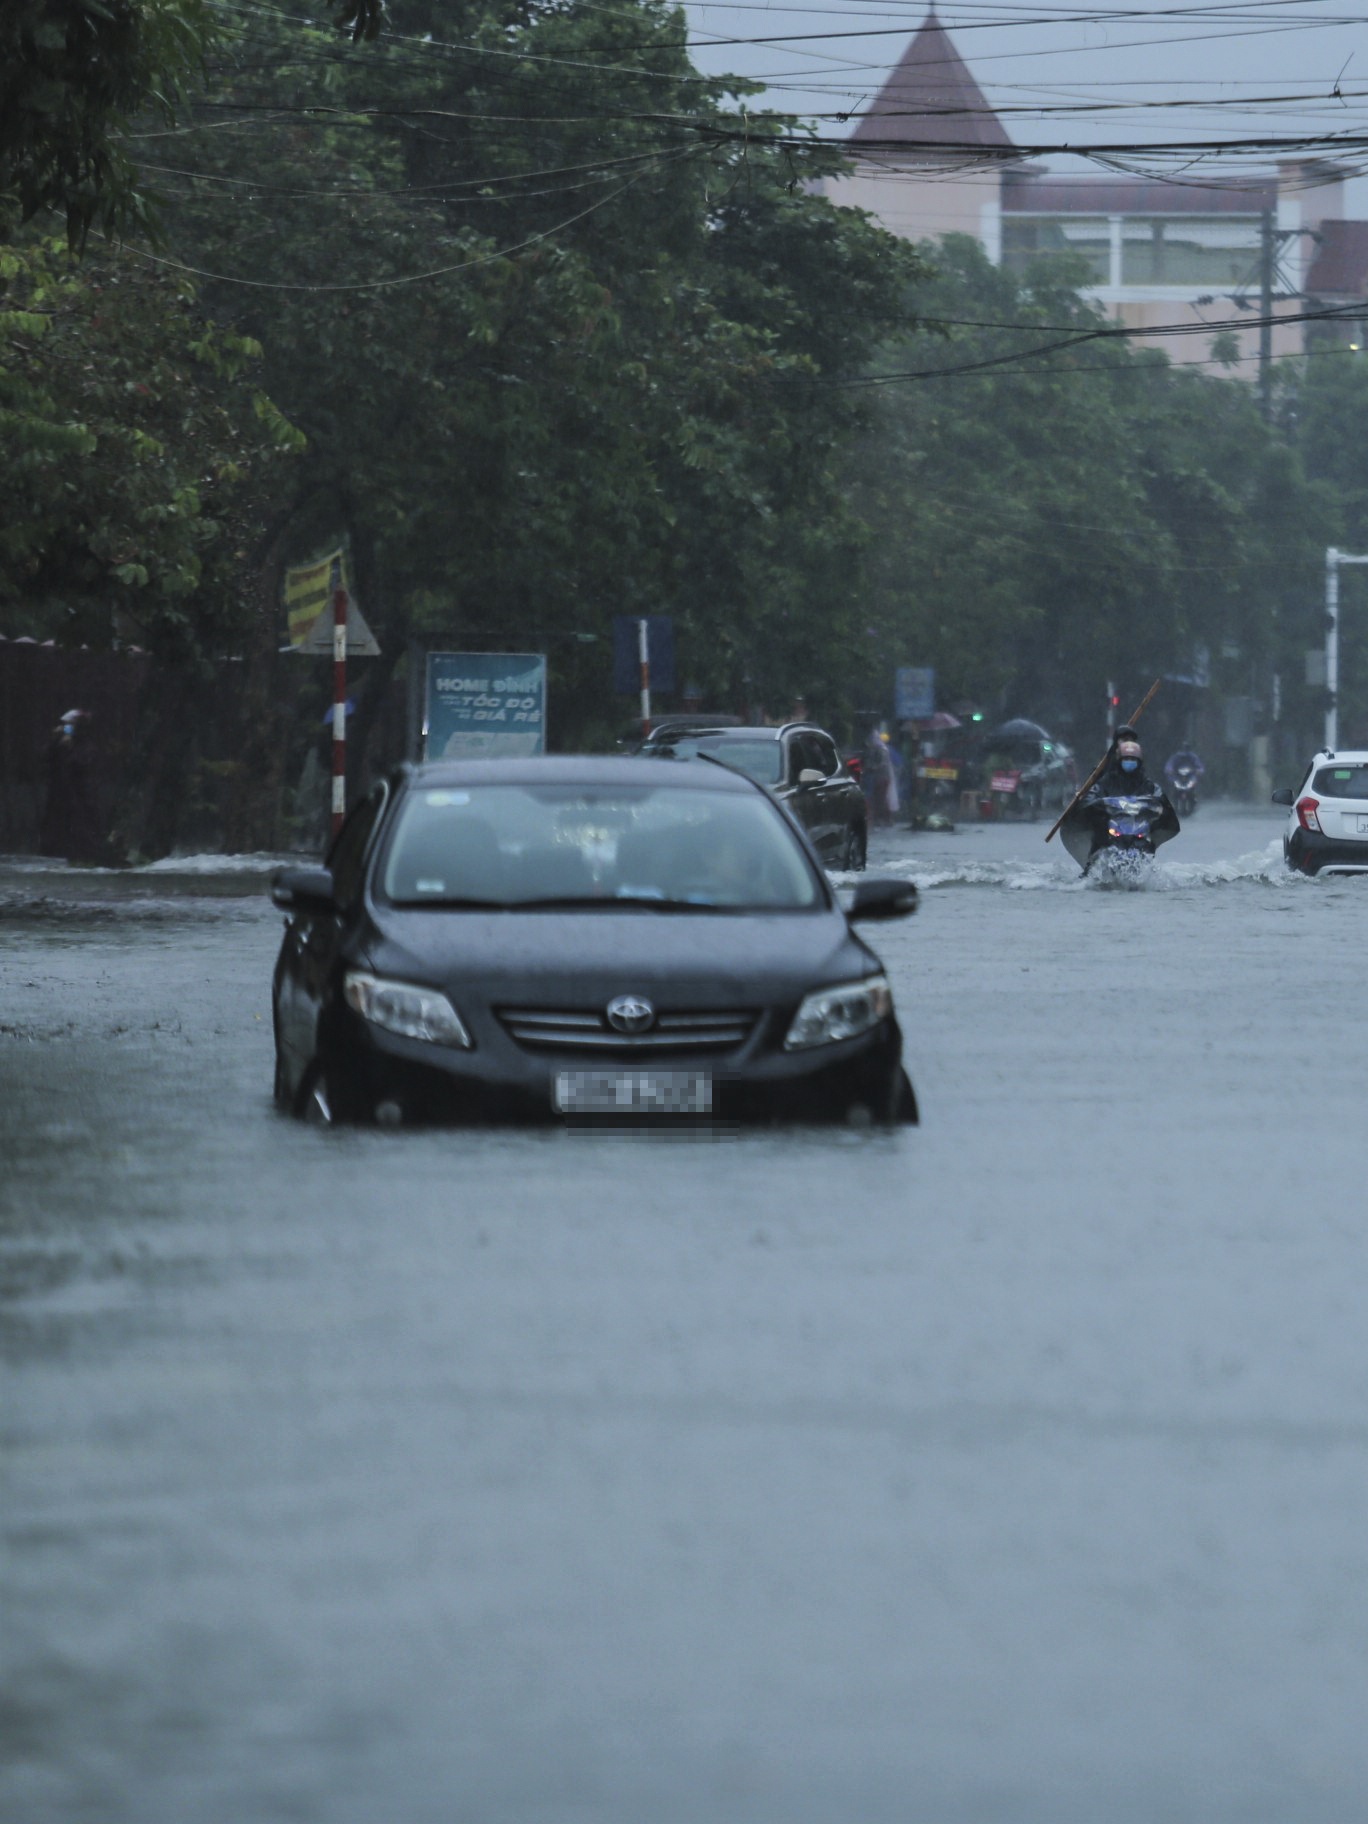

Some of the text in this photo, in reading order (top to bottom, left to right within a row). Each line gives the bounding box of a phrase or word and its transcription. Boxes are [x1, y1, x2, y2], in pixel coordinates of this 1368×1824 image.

[436, 678, 489, 692] HOME
[461, 693, 501, 707] TỐC
[472, 708, 506, 721] GIÁ
